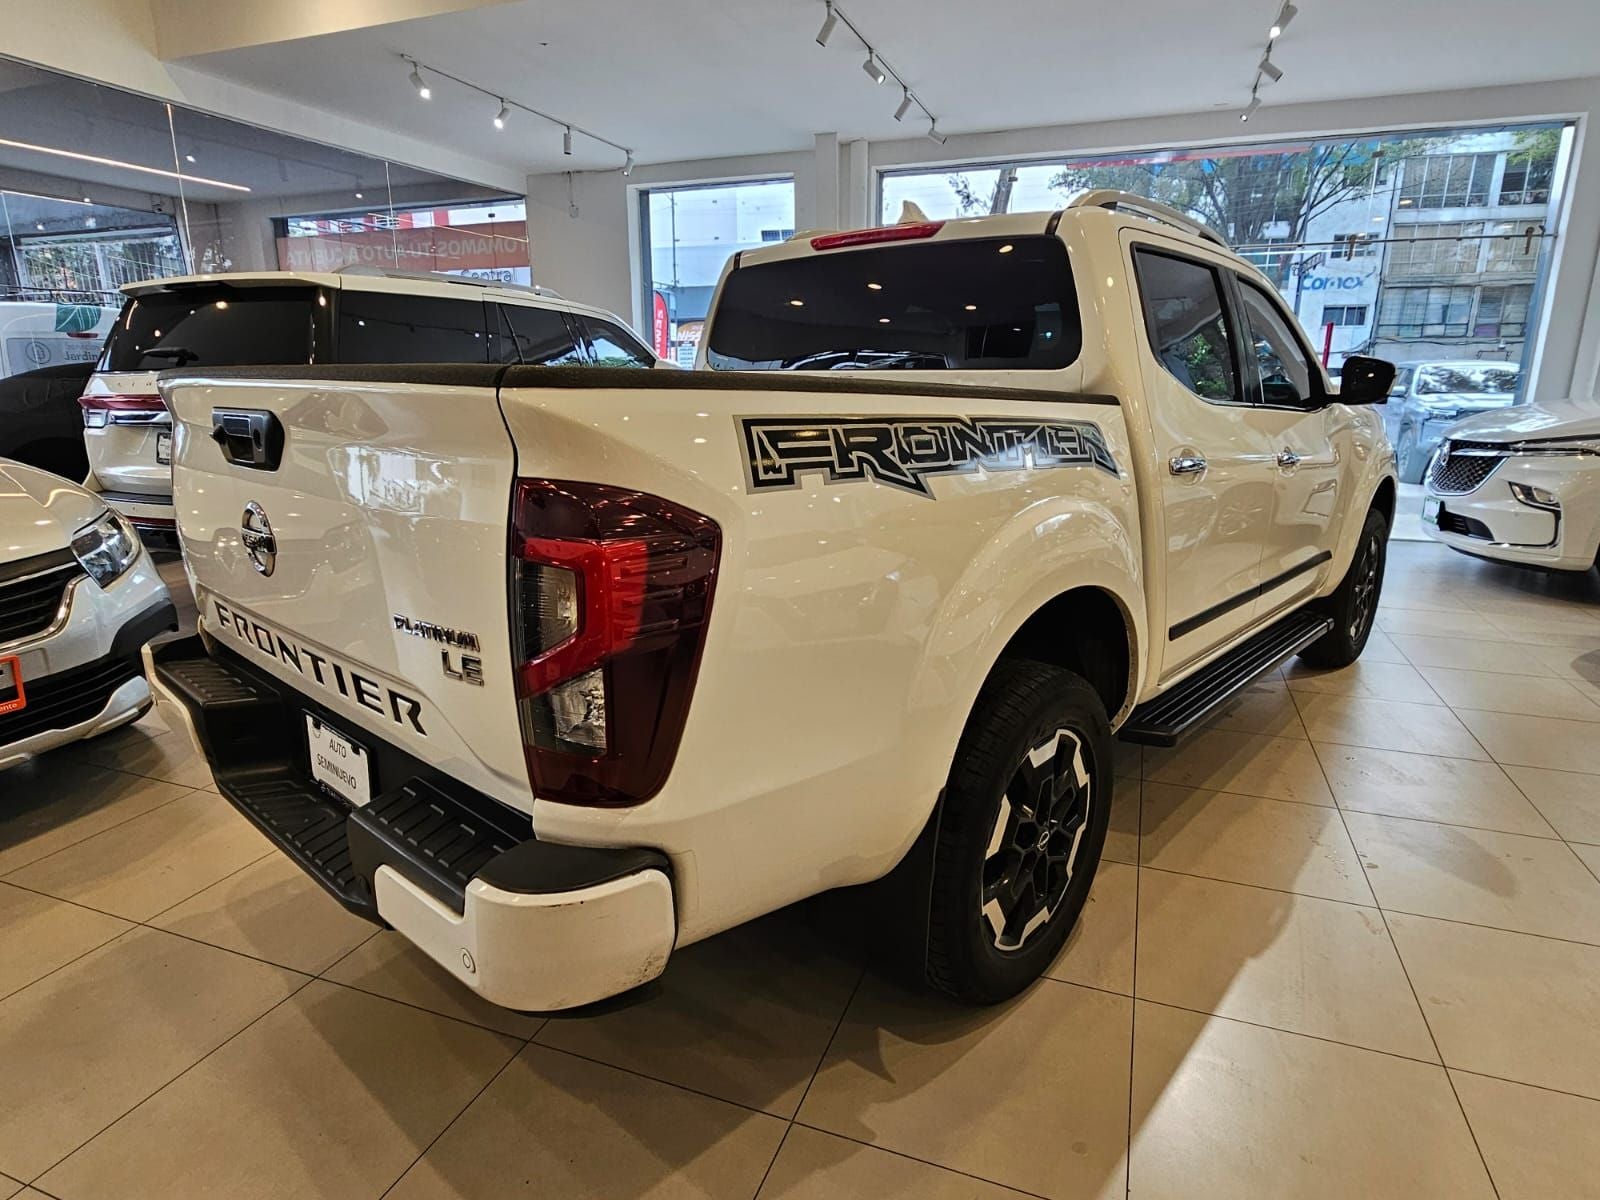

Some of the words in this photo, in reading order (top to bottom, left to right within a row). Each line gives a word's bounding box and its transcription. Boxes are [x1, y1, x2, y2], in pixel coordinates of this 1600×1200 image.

[393, 613, 481, 652] PLATINUM
[213, 600, 428, 737] FRONTIER
[441, 648, 485, 687] LE
[329, 737, 347, 758] AUTO
[316, 752, 357, 790] SEMINUEVO
